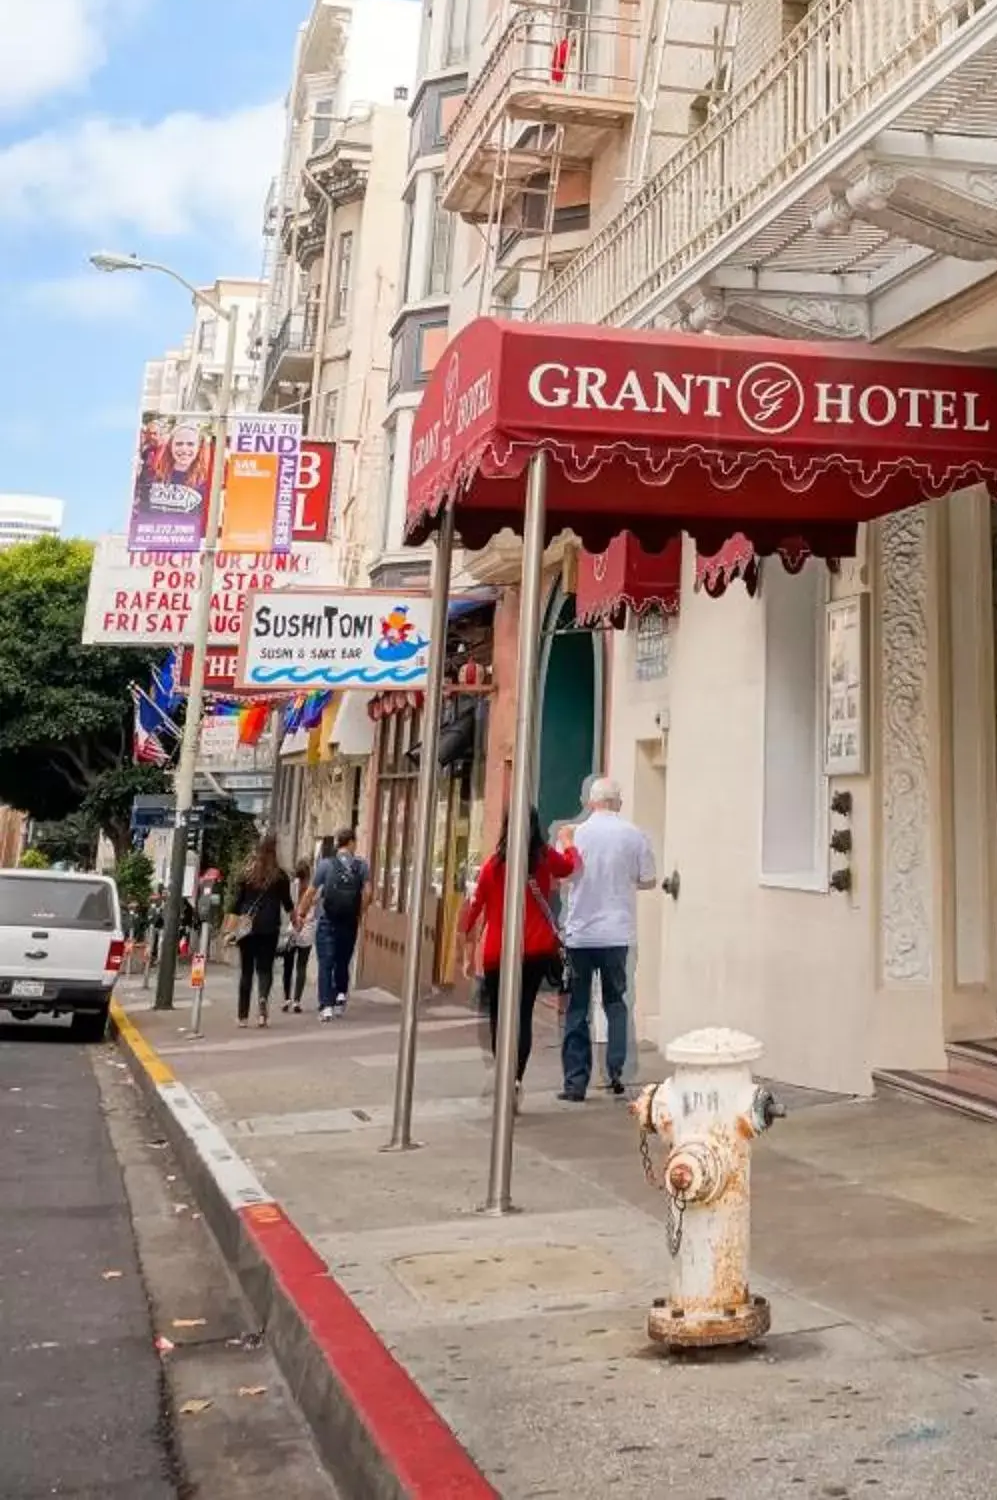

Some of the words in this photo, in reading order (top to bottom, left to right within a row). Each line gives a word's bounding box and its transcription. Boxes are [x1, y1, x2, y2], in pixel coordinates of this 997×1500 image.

[528, 361, 731, 418] GRANT
[814, 383, 991, 432] HOTEL
[239, 421, 276, 435] WALK
[281, 422, 298, 436] TO
[236, 435, 298, 454] END
[129, 550, 193, 568] TOUCH
[248, 551, 310, 572] JUNK!
[153, 571, 204, 589] POR
[222, 573, 275, 591] STAR
[115, 591, 193, 611] RAFAEL
[103, 612, 139, 632] FRI
[146, 613, 190, 633] SAT
[208, 615, 241, 633] UG
